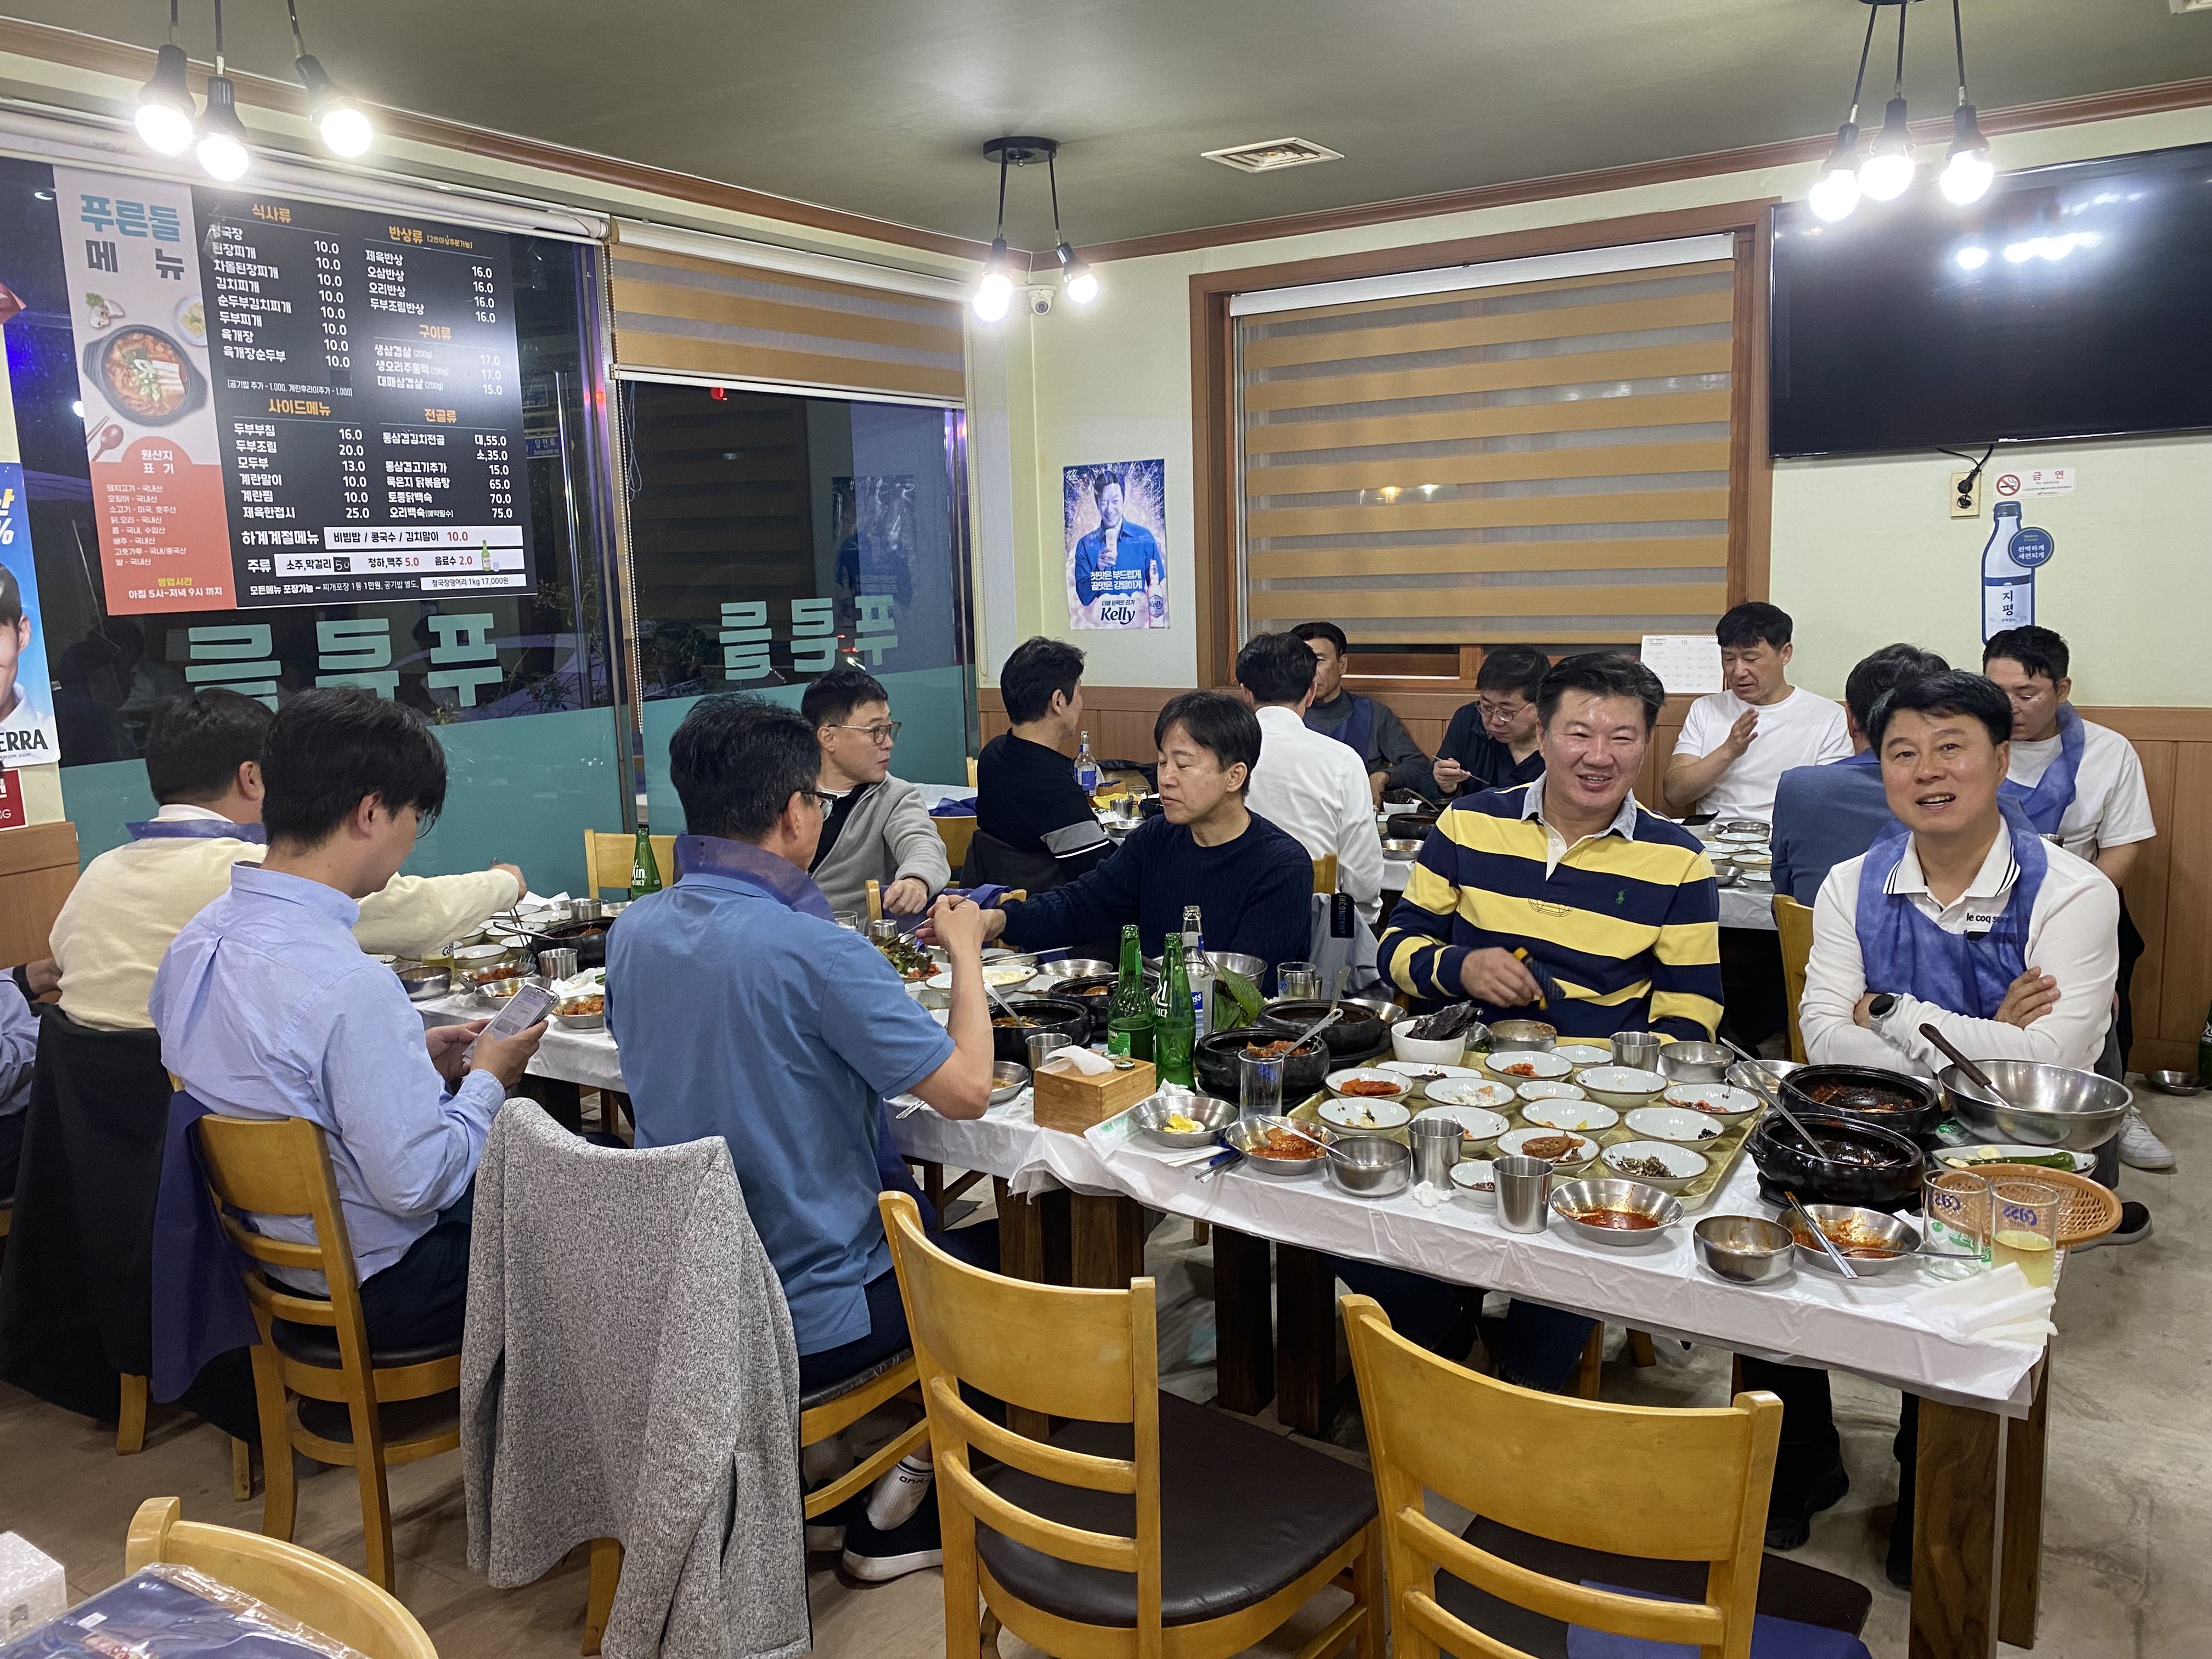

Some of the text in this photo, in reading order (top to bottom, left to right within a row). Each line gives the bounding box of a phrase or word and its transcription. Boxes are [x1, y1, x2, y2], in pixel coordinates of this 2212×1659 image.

[81, 194, 181, 242] 푸른들
[252, 204, 292, 223] 식사류
[388, 225, 424, 244] 반상류
[314, 240, 340, 255] 10.0
[212, 242, 341, 270] 된장찌개 10.0
[365, 249, 493, 279] 제육반상 16.0
[213, 259, 342, 287] 차돌된장찌개 10.0
[367, 266, 494, 294] 오삼반상 16.0
[215, 276, 344, 304] 김치찌개 10.0
[369, 281, 495, 308] 오리반상 16.0
[218, 294, 346, 320] 순두부김치찌개 10.0
[370, 297, 496, 323] 두부조림반상 16.0
[219, 311, 347, 336] 두부찌개 10.0
[221, 329, 349, 352] 육개장 10.0
[419, 324, 452, 341] 구이류
[223, 345, 351, 368] 육개장순두부 10.0
[374, 343, 412, 359] 생삼겹살
[480, 354, 500, 366] 17.0
[481, 369, 501, 381] 17.0
[251, 381, 264, 391] 추가
[289, 383, 331, 395] 계란후라이추가
[377, 375, 424, 390] 대패삼겹살
[482, 383, 503, 396] 15.0
[268, 398, 331, 416] 사이드메뉴
[424, 408, 457, 424] 전골류
[234, 422, 363, 440] 두부부침 16.0
[235, 439, 364, 456] 두부조림 20.0
[382, 432, 507, 447] 통삼겹김치전골 대,55.0
[141, 449, 173, 461] 원산지
[476, 449, 509, 462] 소,35.0
[238, 456, 366, 472] 모두부 13.0
[385, 460, 510, 476] 통삼겹고기추가 15.0
[106, 484, 136, 493] 돼지고기
[239, 473, 367, 488] 계란말이 10.0
[386, 476, 511, 490] 묵은지 닭볶음탕 65.0
[241, 490, 369, 503] 계란찜 10.0
[388, 492, 512, 504] 토종닭백숙 70.0
[242, 506, 370, 519] 제육한접시 25.0
[492, 507, 513, 518] 75.0
[241, 530, 469, 545] 하계계절메뉴 비빔밥 콩국수 김치말이 10.0
[247, 558, 272, 573] 주류
[286, 558, 331, 571] 소주,막걸리
[368, 557, 403, 569] 청하,맥주
[405, 557, 419, 567] 5.0
[435, 556, 457, 567] 음료수
[459, 556, 472, 566] 2.0
[157, 577, 193, 587] 영업시간
[432, 577, 509, 588] 청국장덩어리 1kg 17,000원
[1090, 569, 1142, 581] 첫맛은 부드럽게
[250, 585, 281, 596] 모든메뉴
[283, 584, 314, 594] 포장가능
[323, 582, 349, 592] 찌개포장
[384, 580, 404, 590] 공기밥
[1114, 580, 1142, 590] 강렬하게
[128, 589, 147, 600] 아침
[188, 588, 204, 597] 9시
[205, 587, 223, 596] 까지
[1149, 601, 1163, 610] Kelly
[1101, 607, 1136, 625] Kelly
[1966, 913, 1991, 924] le coq
